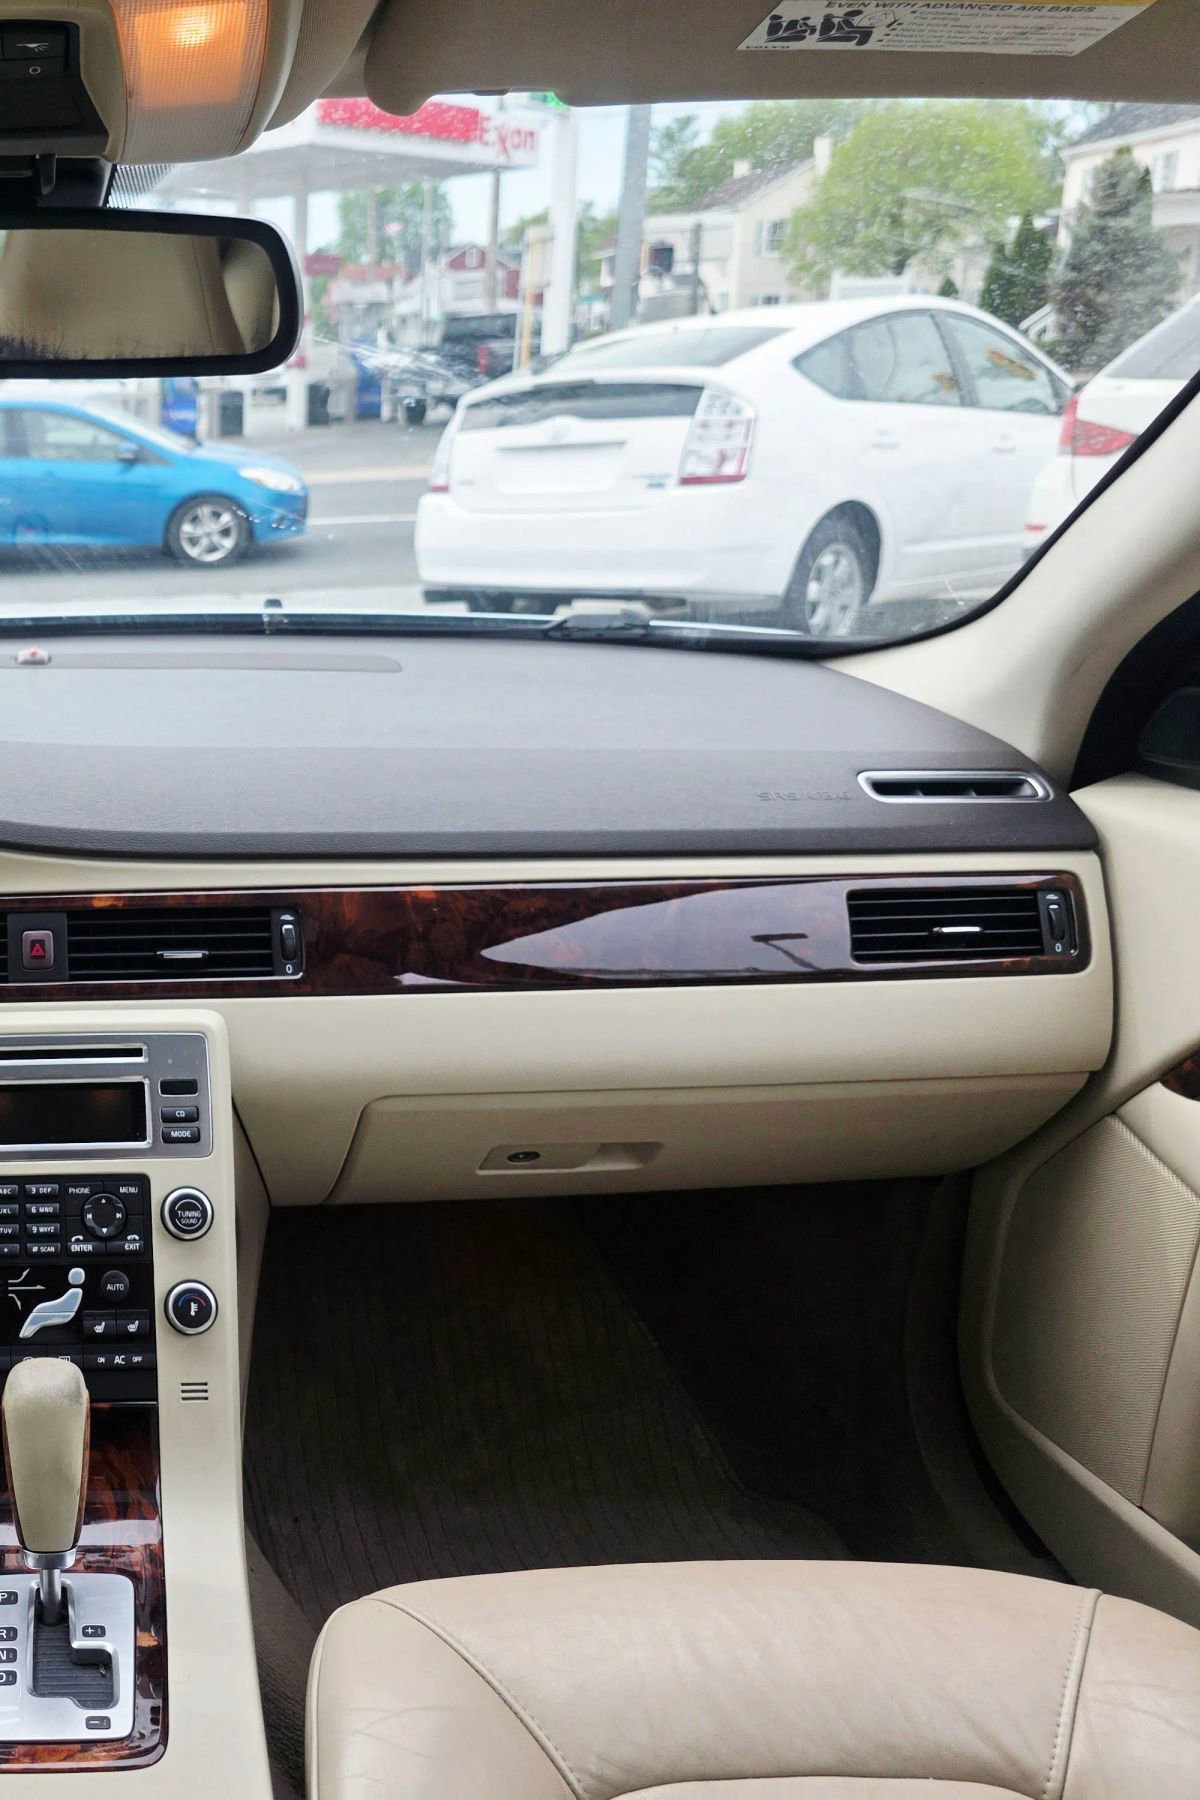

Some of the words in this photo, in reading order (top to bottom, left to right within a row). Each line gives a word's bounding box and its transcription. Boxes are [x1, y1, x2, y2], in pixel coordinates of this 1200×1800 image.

[825, 0, 870, 9] EVEN
[874, 1, 919, 10] WITH
[917, 2, 1014, 12] ADVANCED
[1016, 4, 1046, 13] AIR
[1047, 5, 1097, 13] BAGS
[175, 1110, 186, 1118] CD
[170, 1130, 192, 1138] MODE
[68, 1186, 91, 1194] PHONE
[119, 1186, 138, 1194] MENU
[31, 1206, 37, 1214] 6
[177, 1210, 202, 1218] TUNING
[31, 1226, 38, 1234] 9
[39, 1225, 55, 1233] WXYZ
[39, 1245, 55, 1253] SCAN
[70, 1244, 93, 1252] ENTER
[124, 1243, 140, 1251] EXIT
[106, 1283, 125, 1291] AUTO
[114, 1355, 126, 1364] AC
[0, 1593, 8, 1602] P
